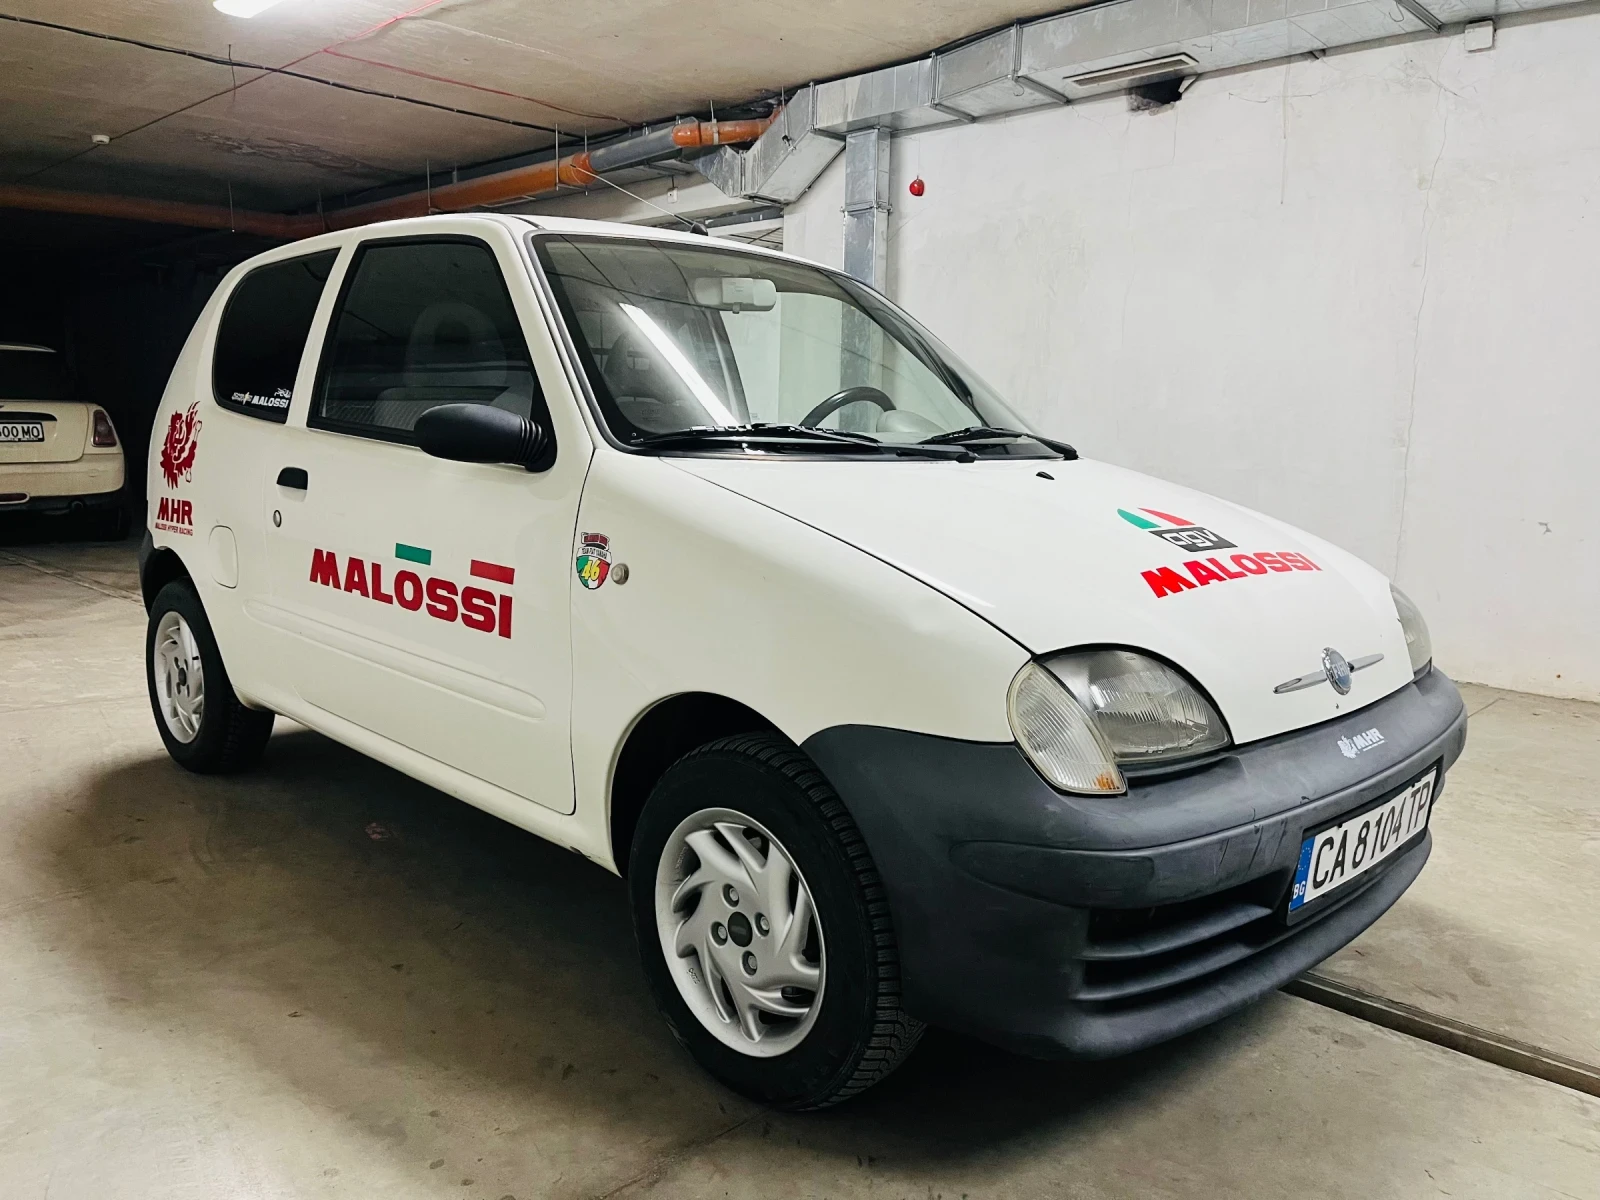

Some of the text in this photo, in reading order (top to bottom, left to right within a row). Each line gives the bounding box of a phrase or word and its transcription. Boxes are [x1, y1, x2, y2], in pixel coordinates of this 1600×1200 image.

[251, 395, 290, 409] MALOSSI
[21, 425, 40, 438] MO
[157, 496, 193, 526] MHR
[581, 558, 601, 582] 46
[1140, 552, 1323, 598] MALOSSI
[309, 548, 513, 639] MALOSSI
[1352, 727, 1385, 750] MHR
[1312, 780, 1431, 890] CA 8104 TP
[1292, 881, 1306, 899] BG
